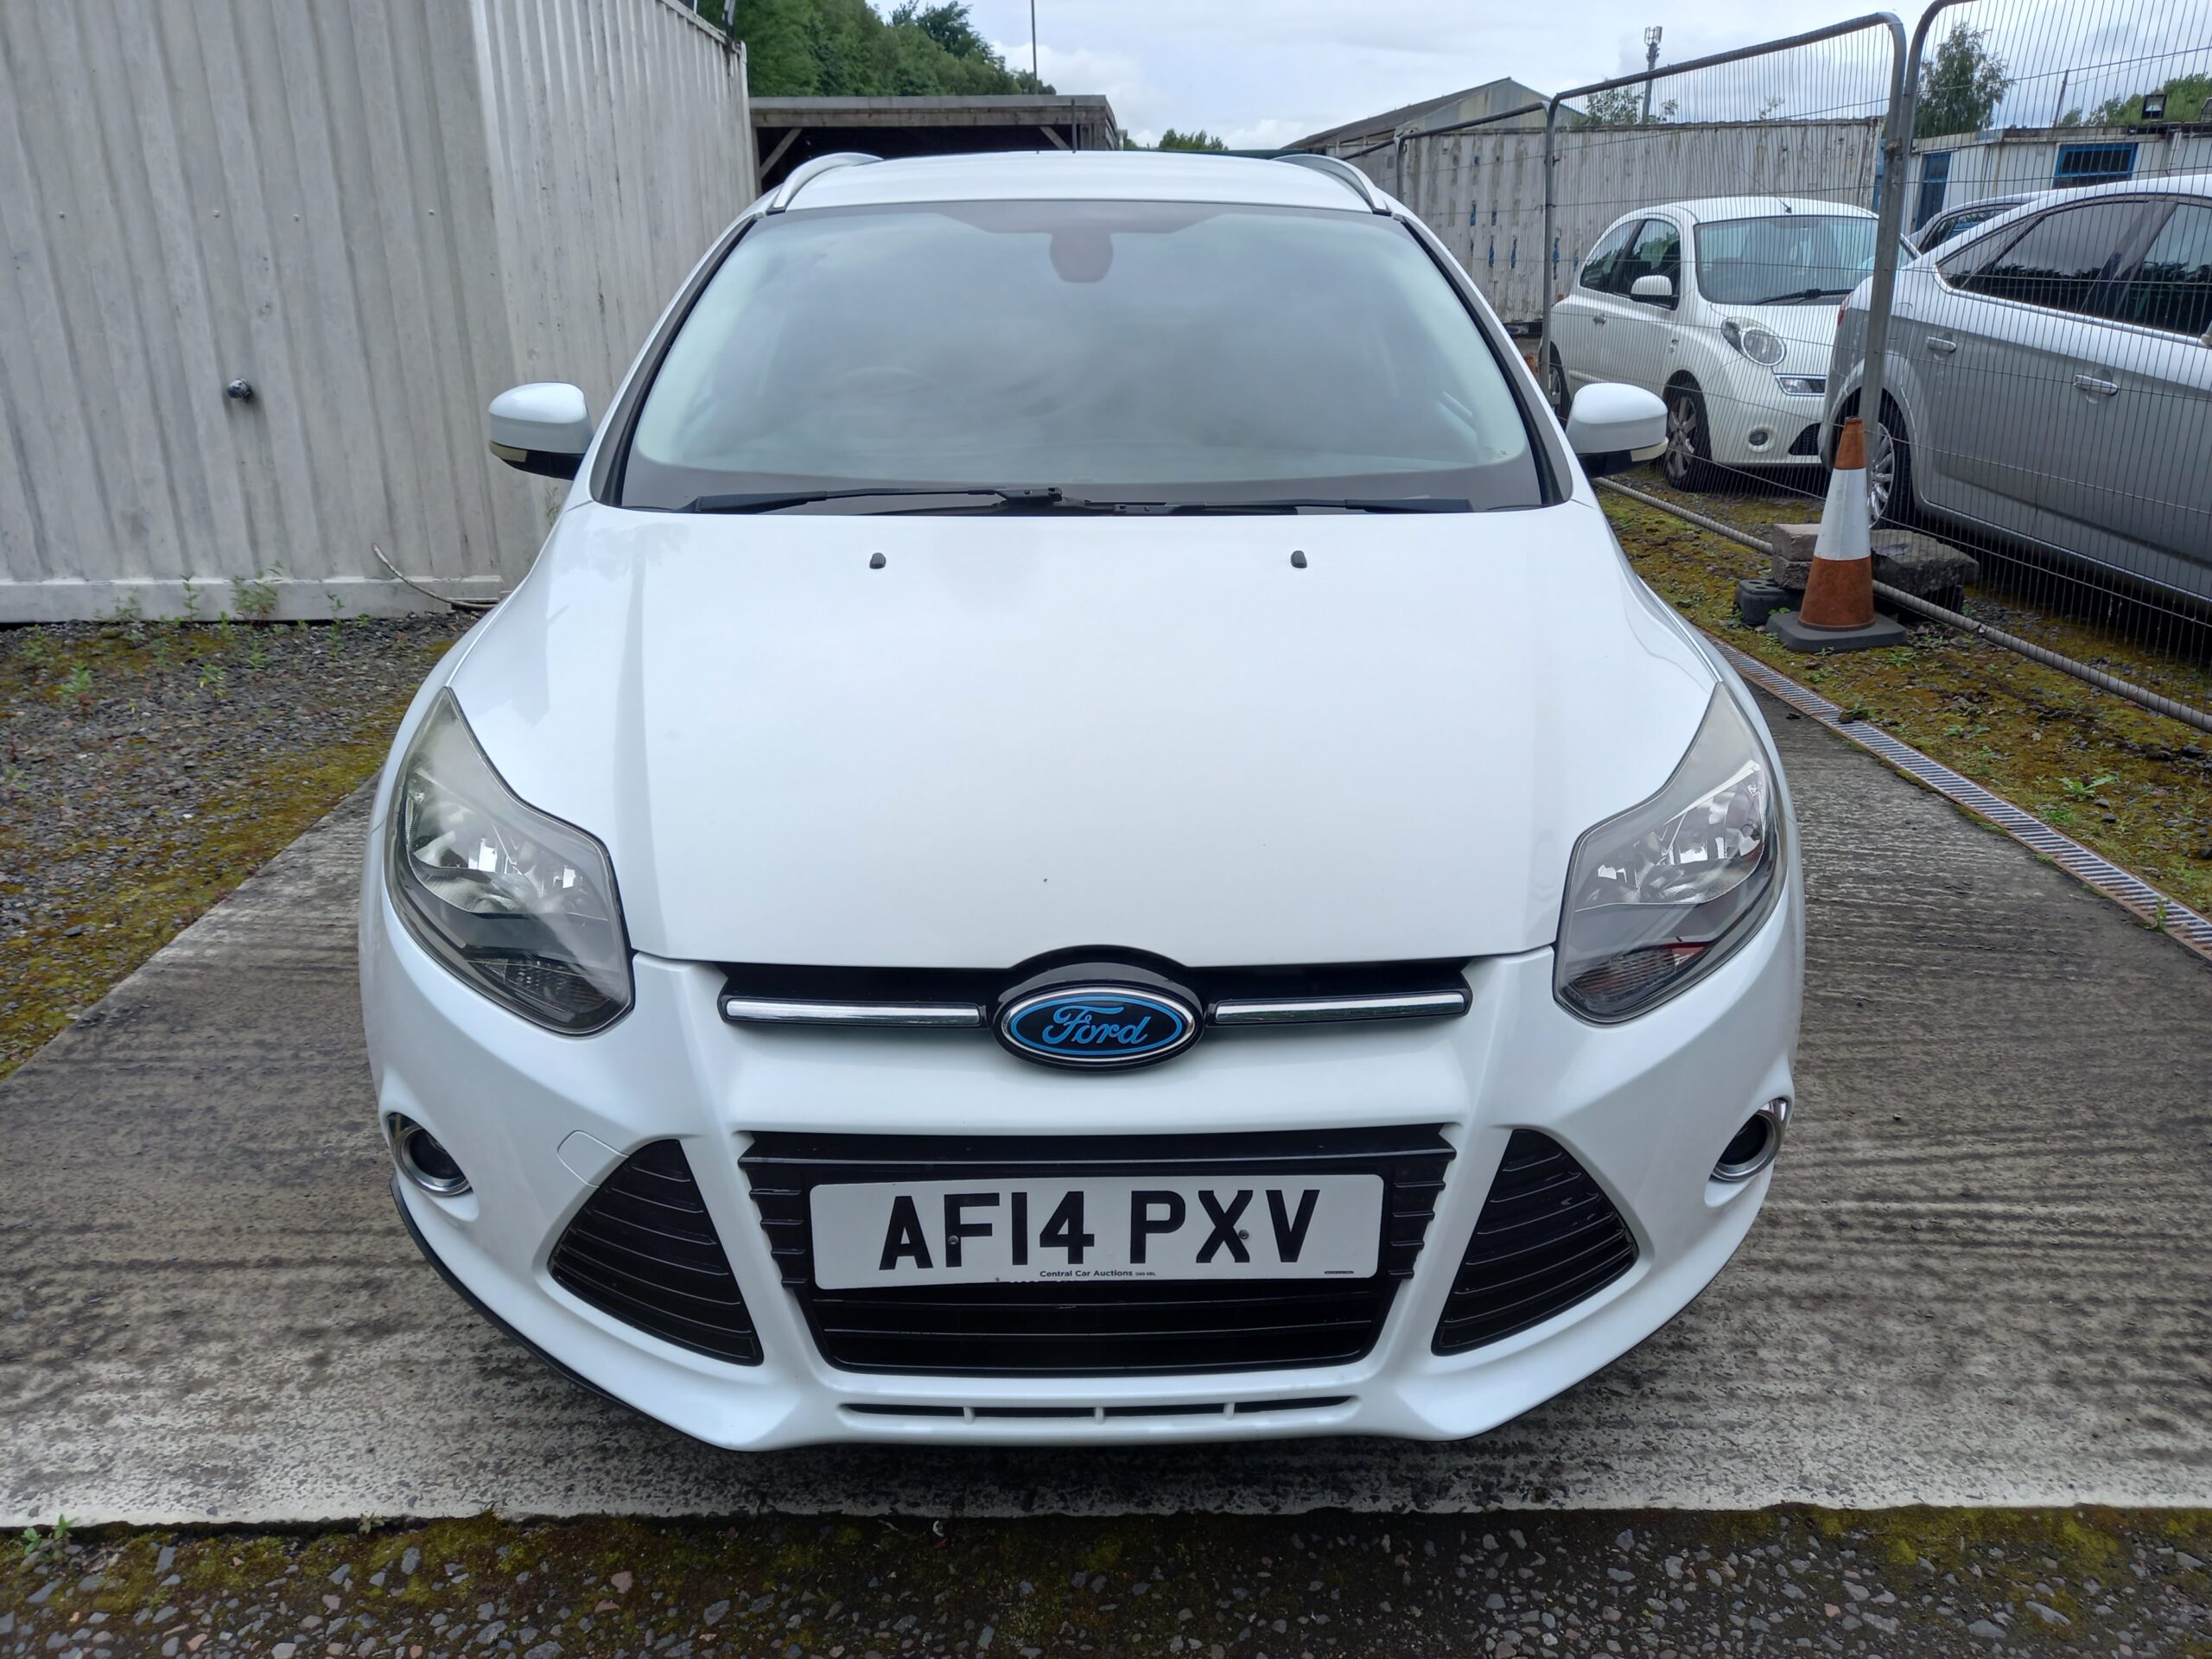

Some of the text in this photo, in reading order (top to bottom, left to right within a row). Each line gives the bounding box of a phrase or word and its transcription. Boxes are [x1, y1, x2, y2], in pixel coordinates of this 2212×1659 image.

[1041, 1005, 1152, 1045] Ford
[878, 1189, 1320, 1270] AF14 PXV
